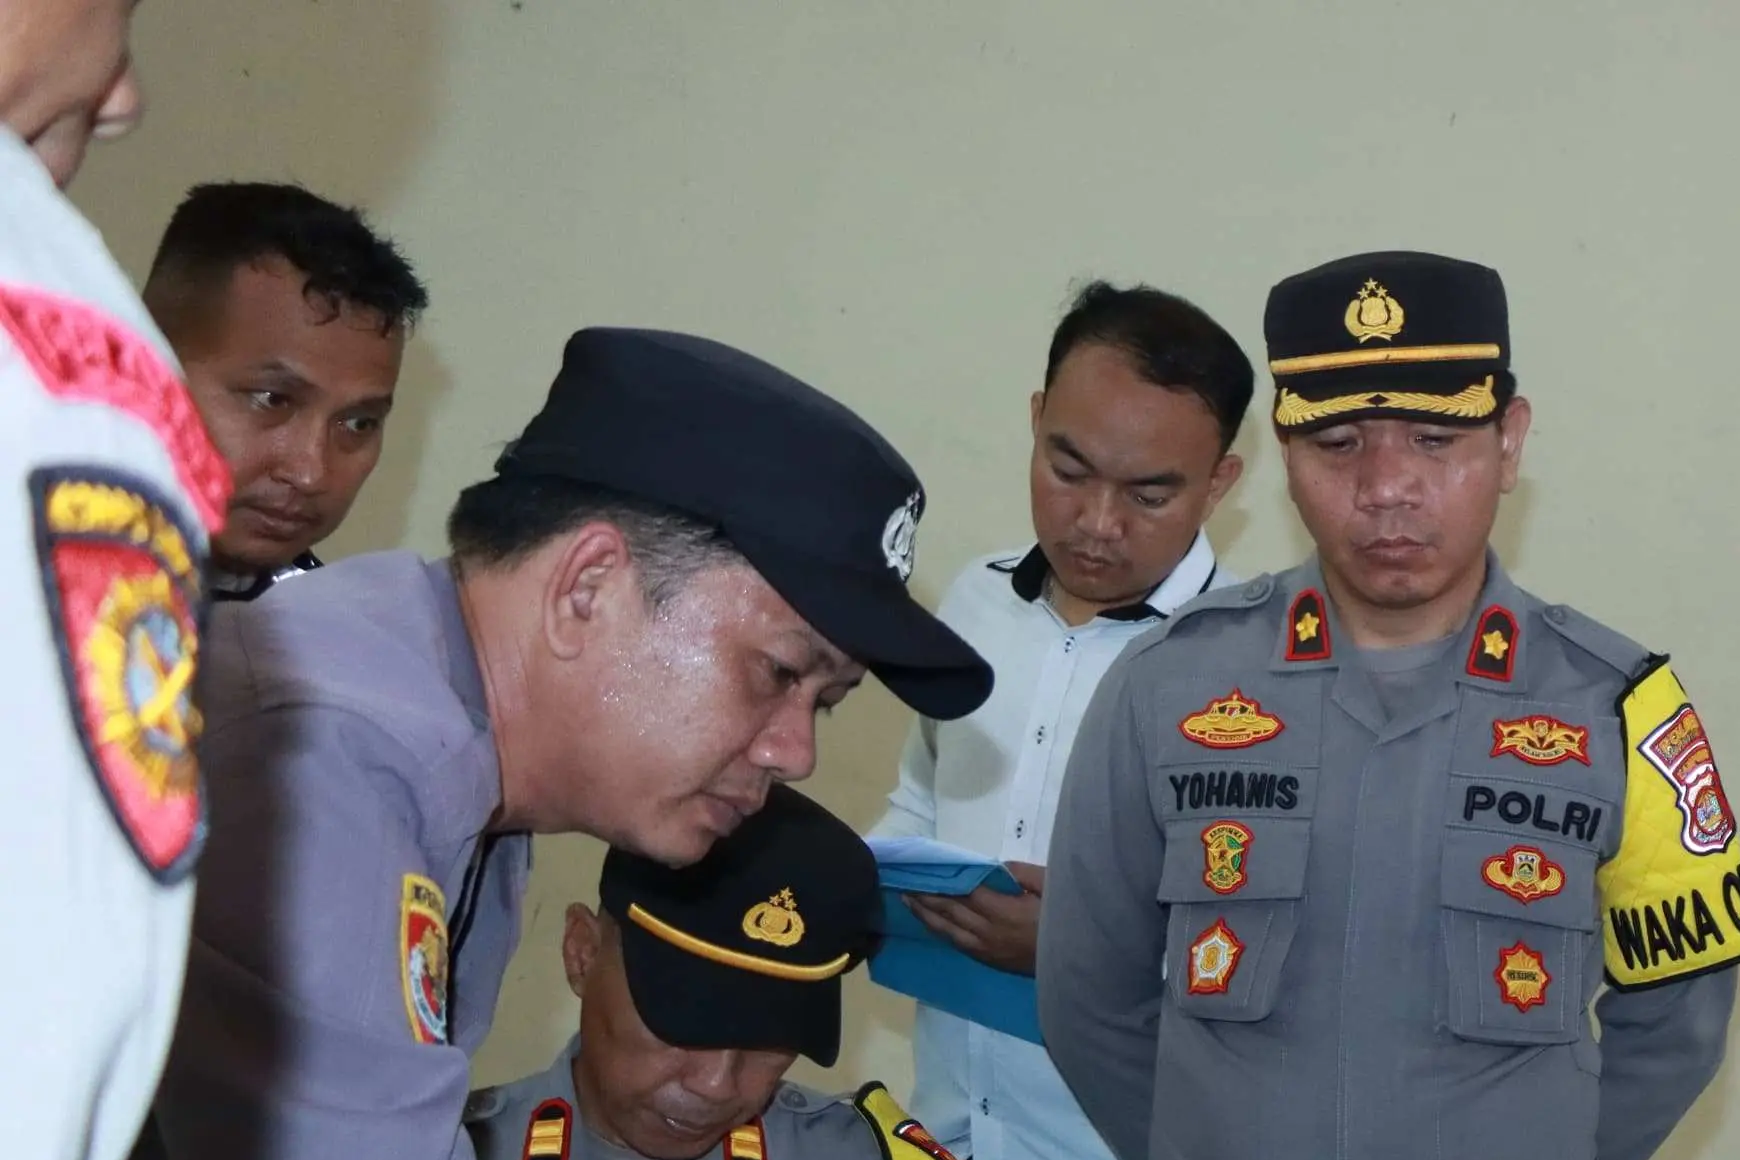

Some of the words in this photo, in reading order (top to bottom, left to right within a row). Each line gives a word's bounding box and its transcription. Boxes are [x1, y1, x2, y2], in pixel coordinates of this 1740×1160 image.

[1169, 771, 1299, 813] YOHANIS
[1463, 785, 1602, 842] POLRI
[1610, 889, 1725, 970] WAKA
